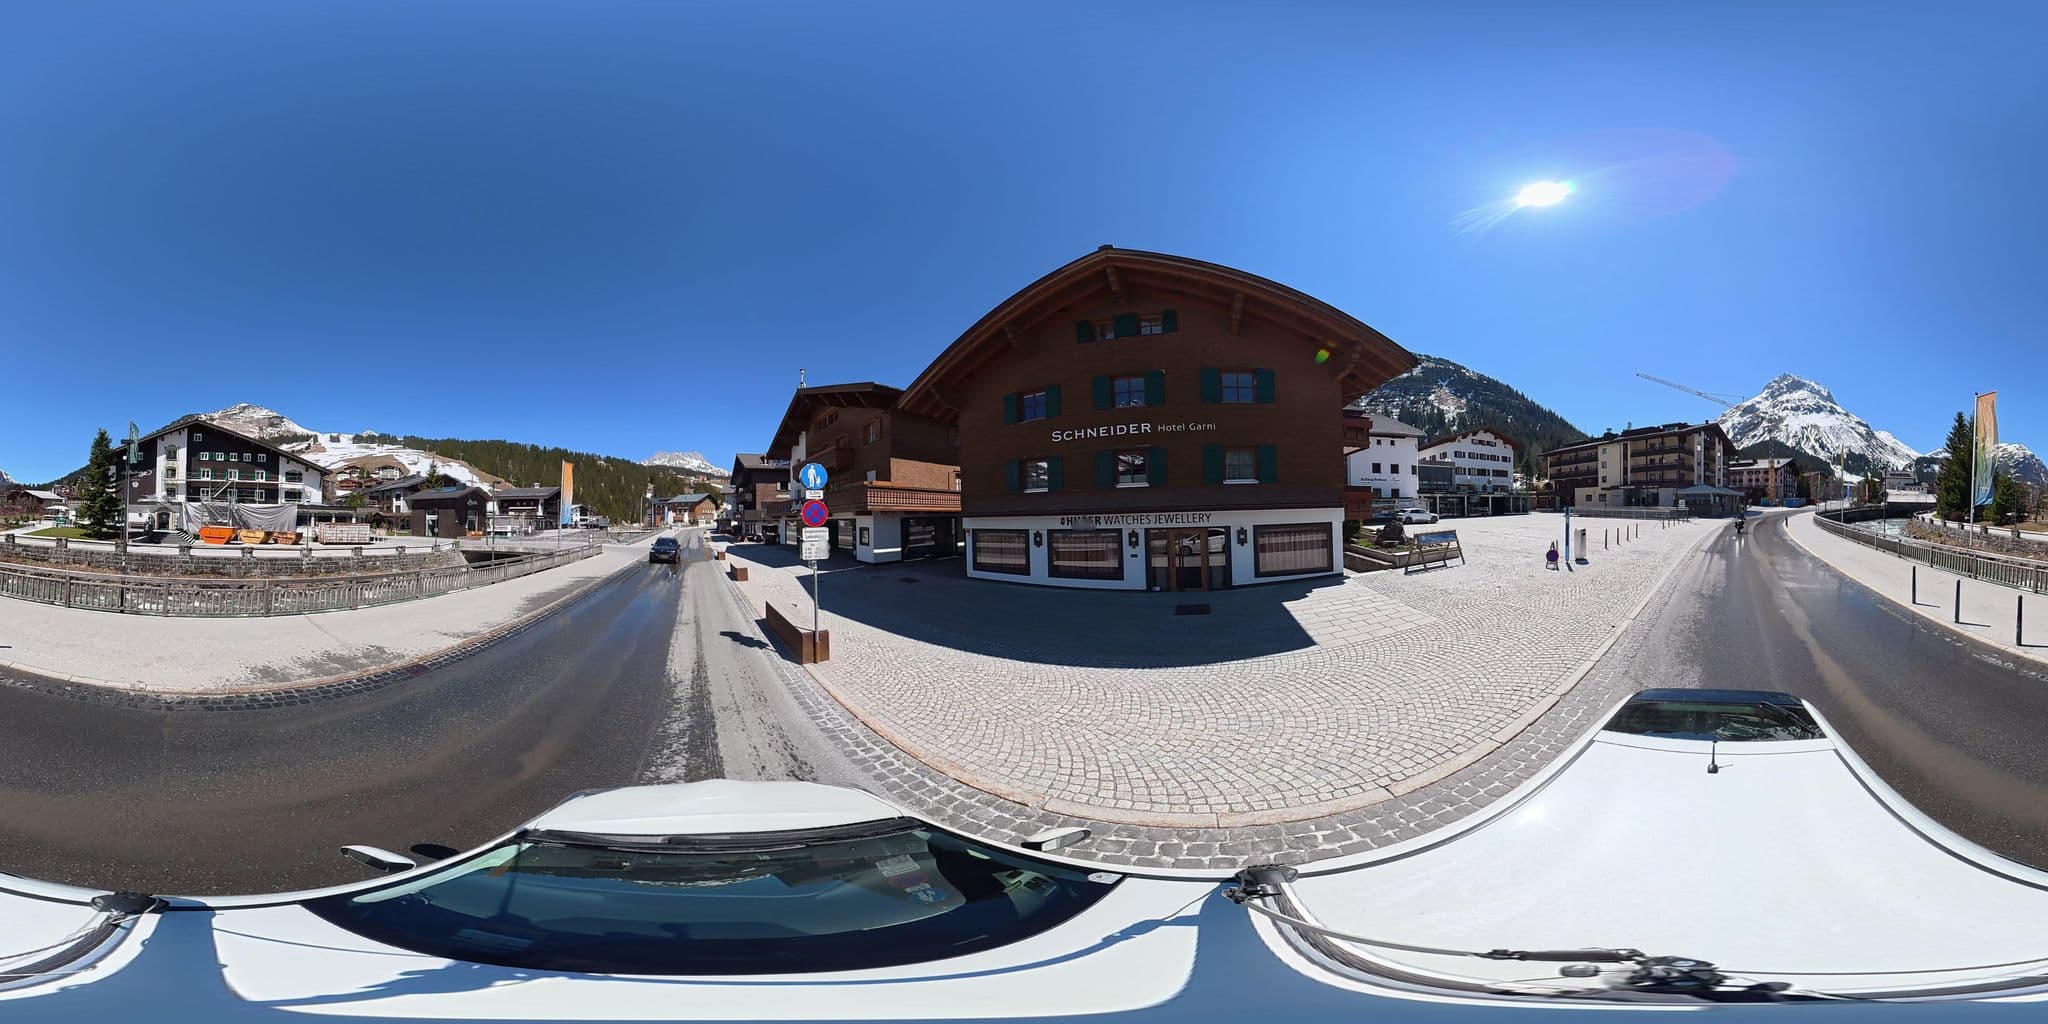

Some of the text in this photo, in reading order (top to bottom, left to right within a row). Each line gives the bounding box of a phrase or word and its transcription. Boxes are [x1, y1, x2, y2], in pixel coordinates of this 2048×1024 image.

[1051, 421, 1217, 442] SCHNEIDER Hotel Garni
[1103, 514, 1151, 525] WATCHES
[1153, 512, 1212, 524] JEWELLERY
